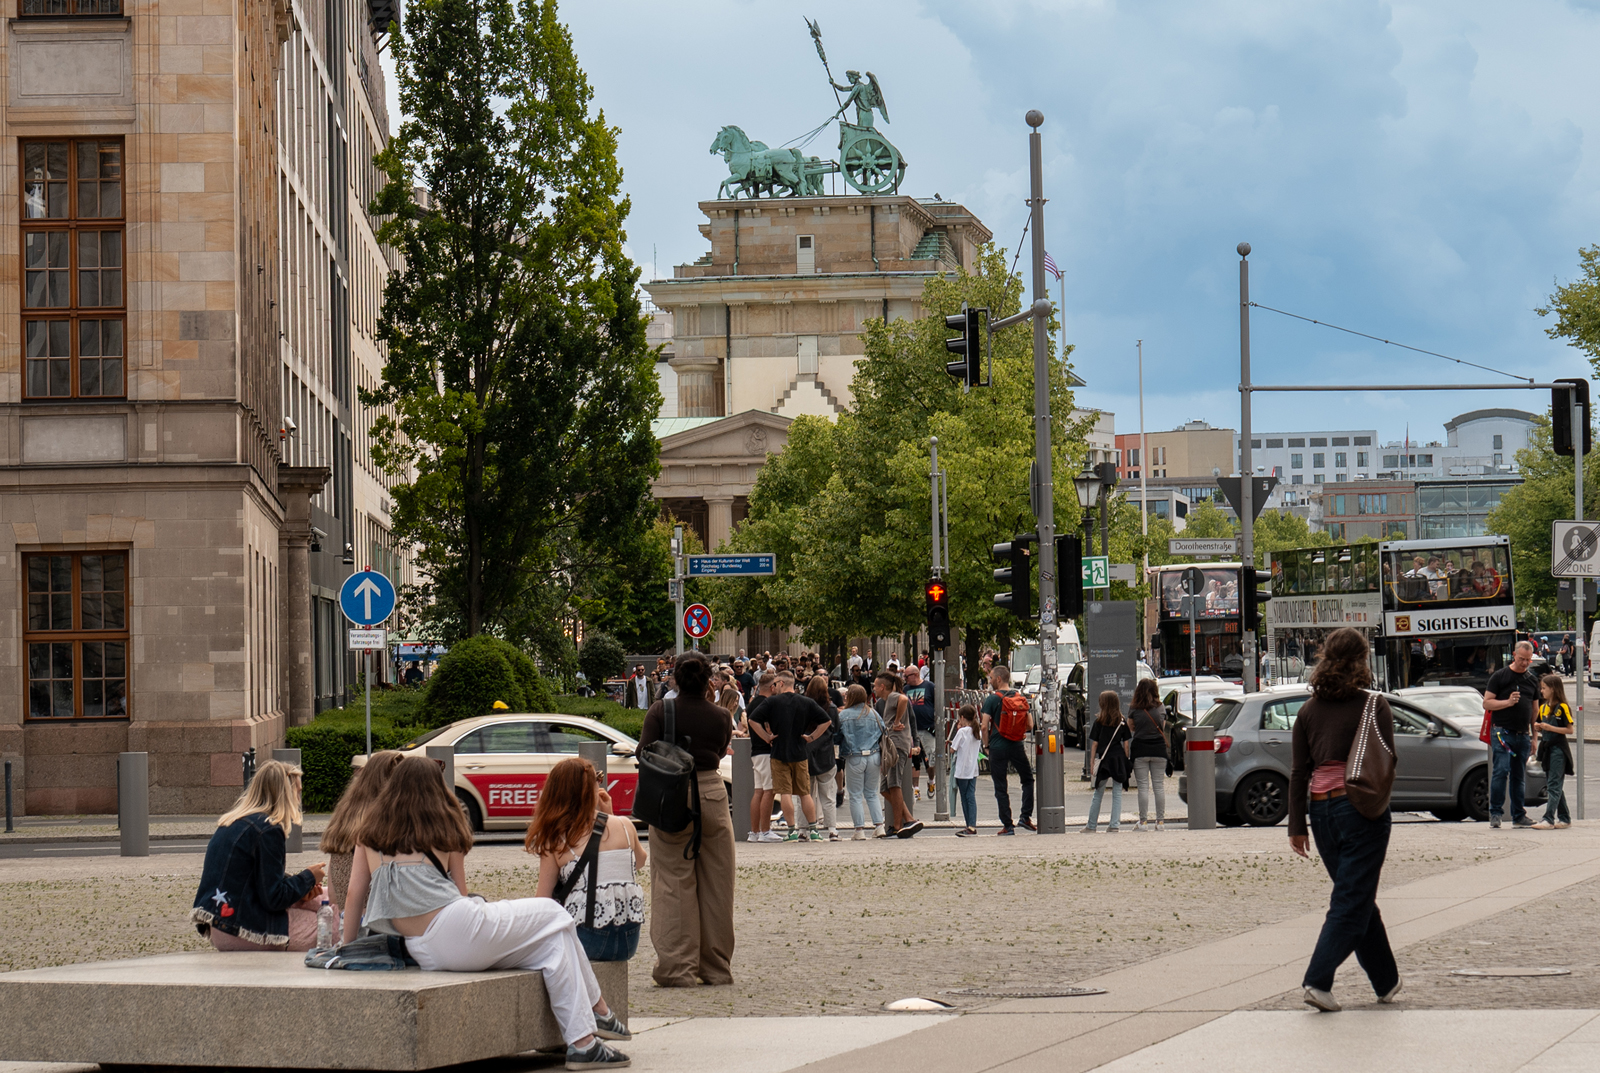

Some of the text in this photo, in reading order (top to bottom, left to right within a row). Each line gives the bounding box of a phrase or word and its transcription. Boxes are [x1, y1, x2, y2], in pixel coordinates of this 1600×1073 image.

[1175, 542, 1232, 551] Dorotheenstraße
[1566, 564, 1593, 572] ZONE
[1417, 614, 1508, 632] SIGHTSEEING
